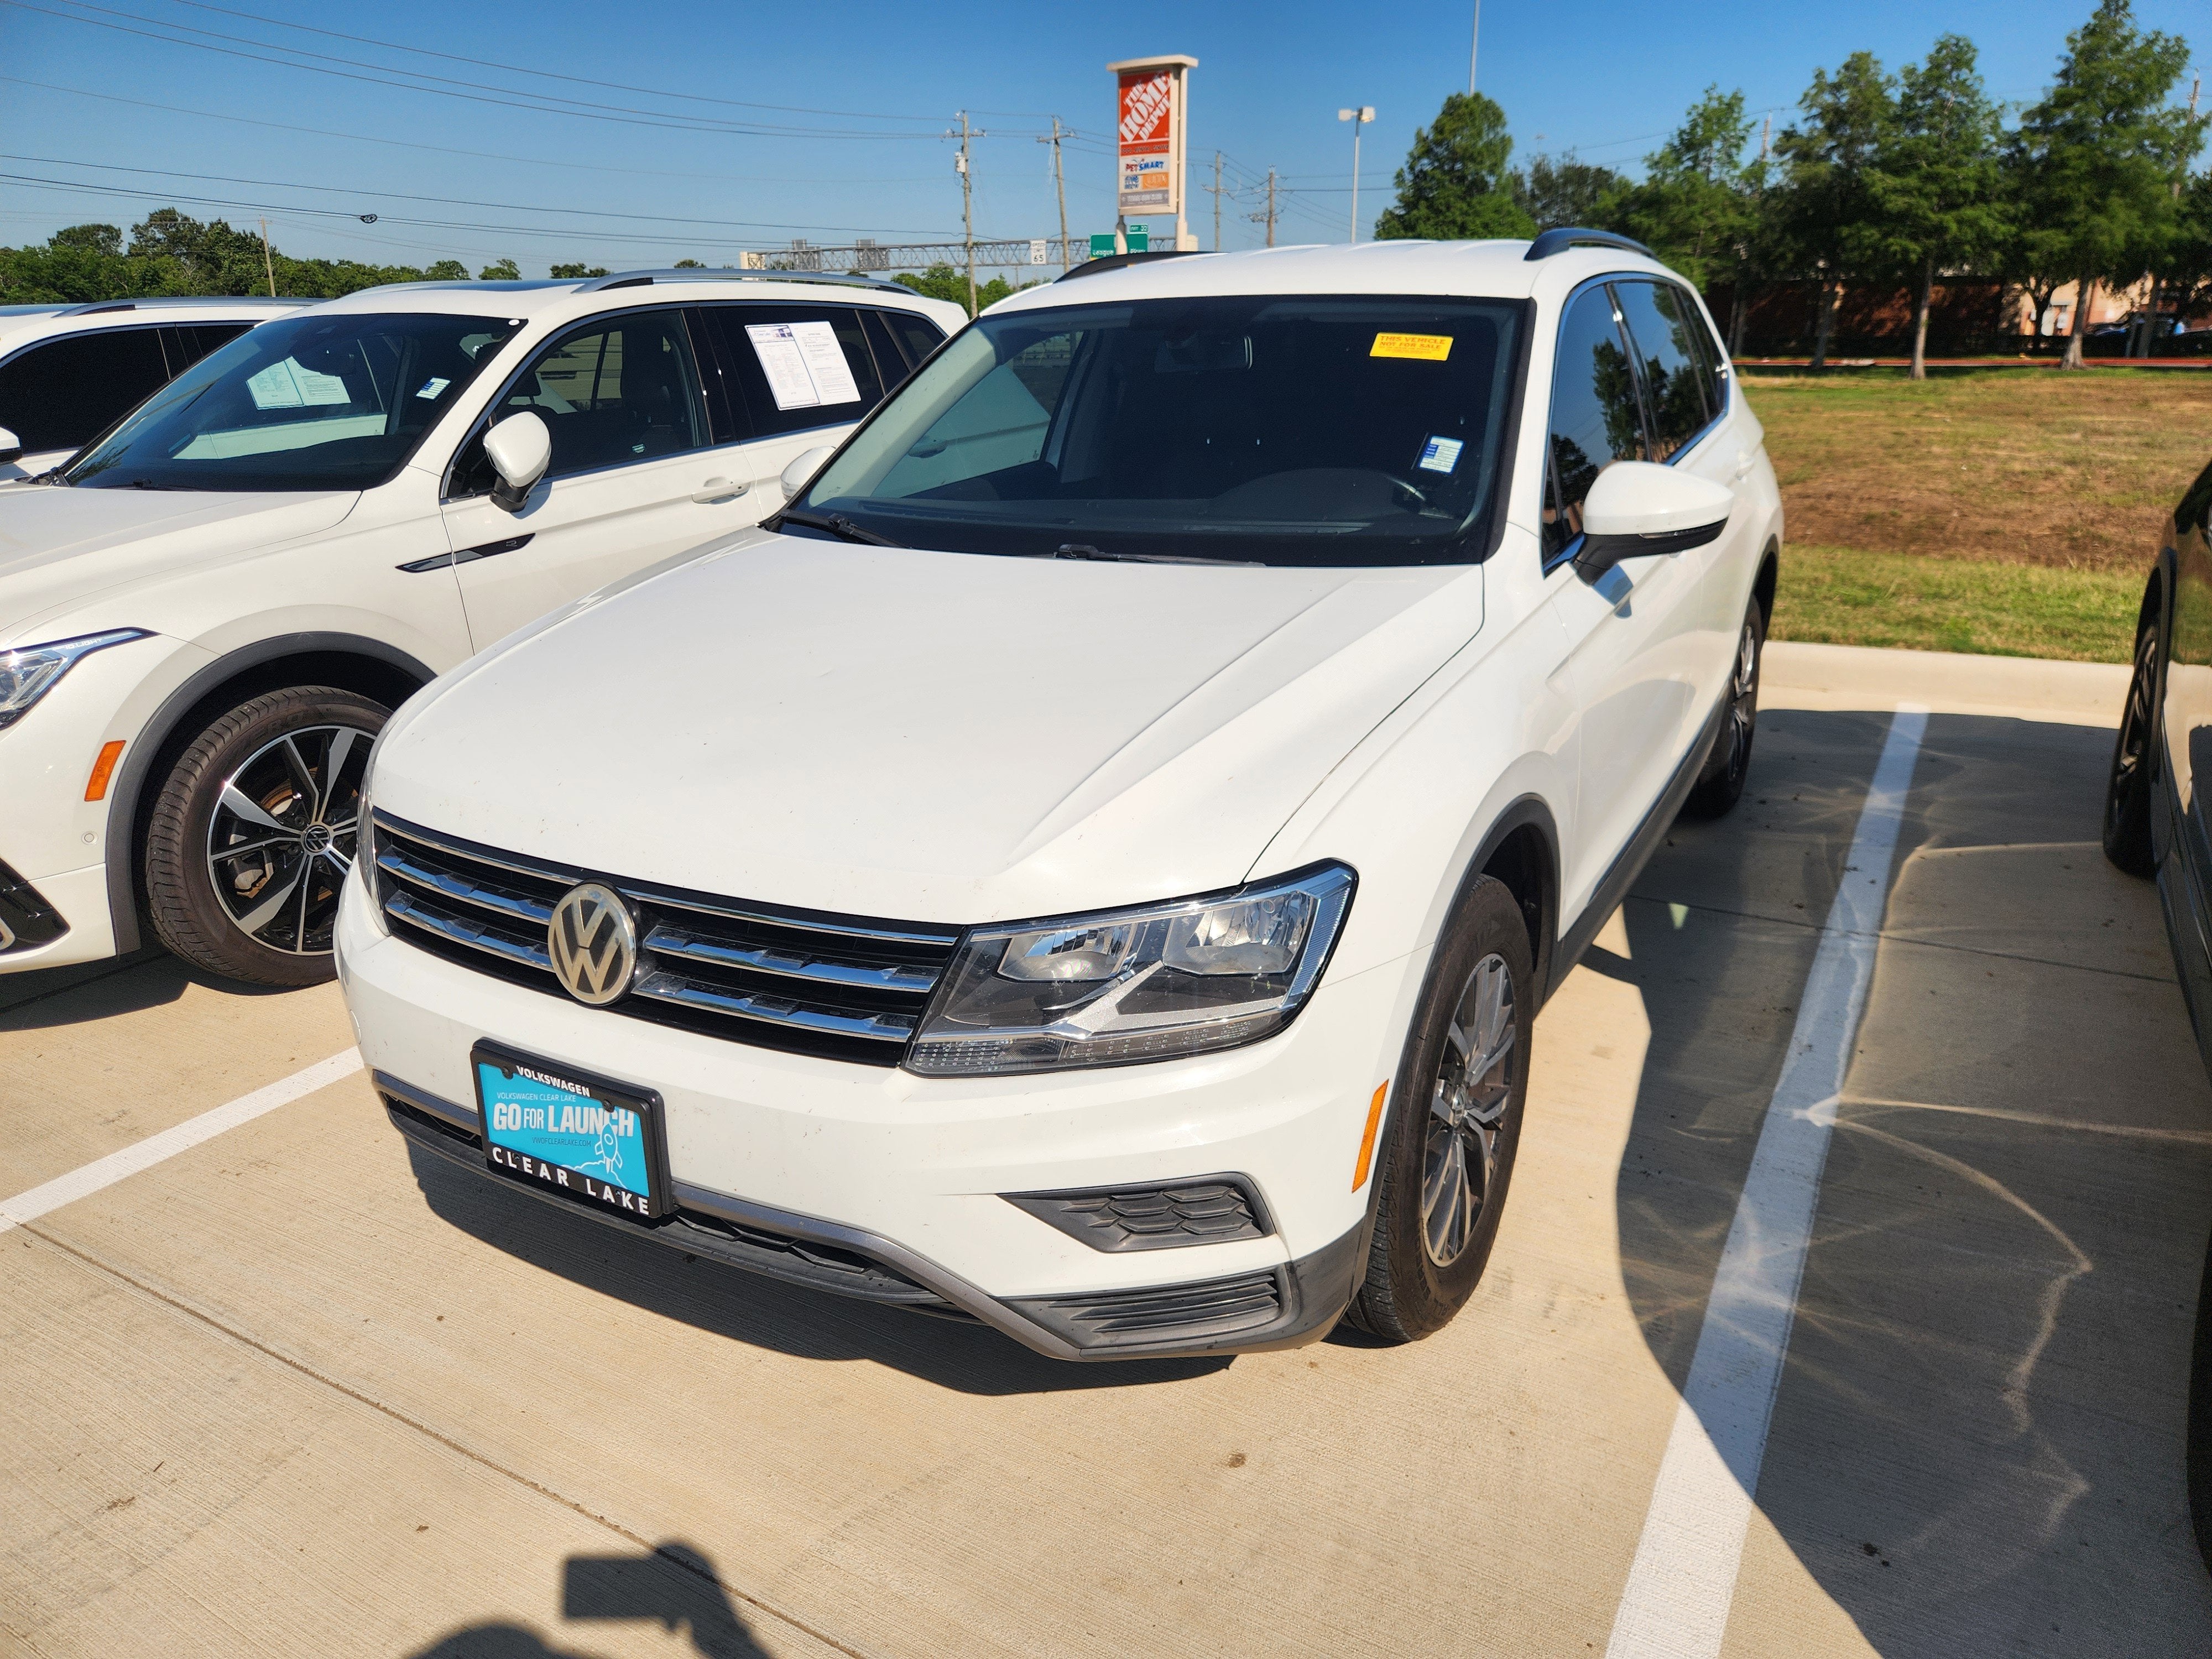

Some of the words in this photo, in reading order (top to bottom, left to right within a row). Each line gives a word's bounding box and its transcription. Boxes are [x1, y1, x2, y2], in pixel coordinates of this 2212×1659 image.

[1119, 76, 1170, 142] HOME
[1124, 83, 1146, 108] THE
[1139, 95, 1170, 141] DEPOT
[497, 1092, 538, 1101] VOLKSWAGEN
[539, 1093, 560, 1102] CLEAR
[560, 1094, 576, 1103] LAKE
[515, 1065, 591, 1098] VOLKSWAGEN
[493, 1102, 521, 1131] GO
[523, 1108, 544, 1129] FOR
[547, 1105, 634, 1138] LAUNCH
[531, 1136, 592, 1147] VWOFCLEARLAKE.COM
[492, 1146, 570, 1187] CLEAR
[586, 1178, 650, 1215] LAKE
